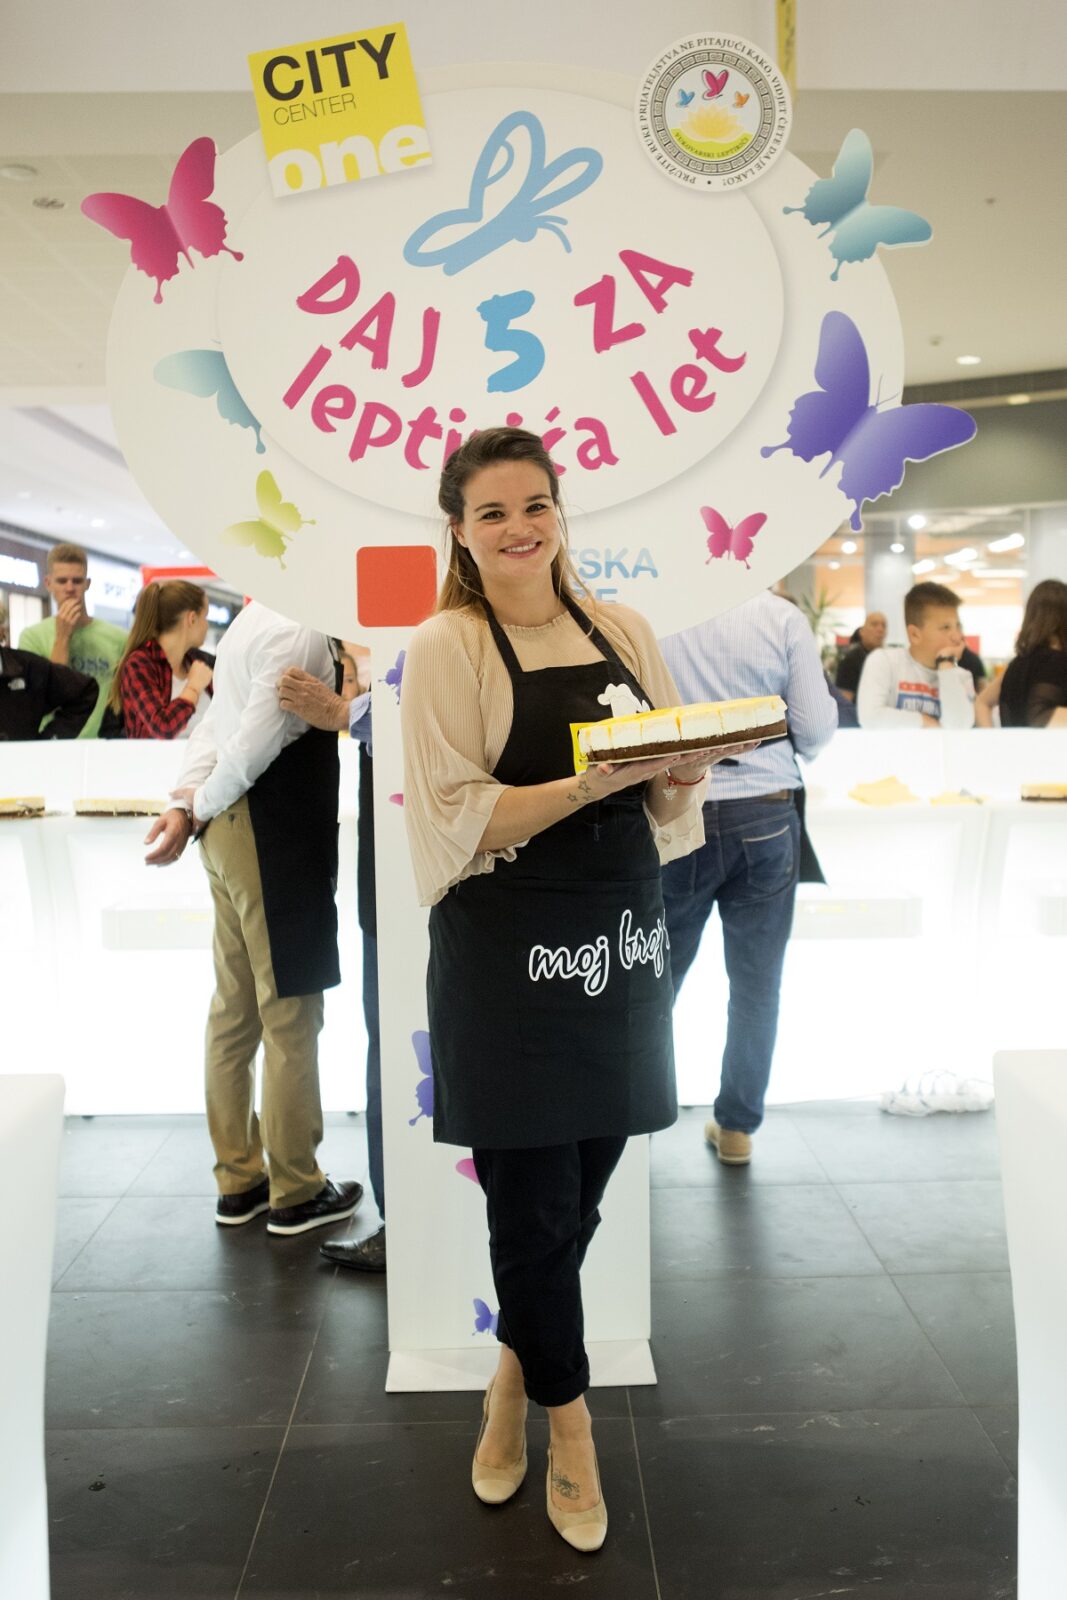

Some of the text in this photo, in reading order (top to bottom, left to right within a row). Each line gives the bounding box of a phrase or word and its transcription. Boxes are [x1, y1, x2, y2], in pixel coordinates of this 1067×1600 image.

[680, 40, 695, 52] NE
[697, 37, 746, 53] PITAJUĆI
[263, 32, 396, 101] CITY
[746, 49, 773, 77] KAKO,
[639, 49, 680, 121] PRIJATELJSTVA
[771, 76, 787, 114] VIDJET
[273, 92, 357, 126] CENTER
[641, 124, 658, 153] RUKE
[763, 146, 777, 160] DA
[267, 124, 432, 198] one
[655, 153, 697, 184] PRUŽITE
[722, 168, 755, 186] LAKO!
[296, 249, 694, 392] DAJ 5 ZA
[283, 327, 747, 476] leptića let
[528, 935, 609, 997] moj
[618, 909, 664, 979] broj
